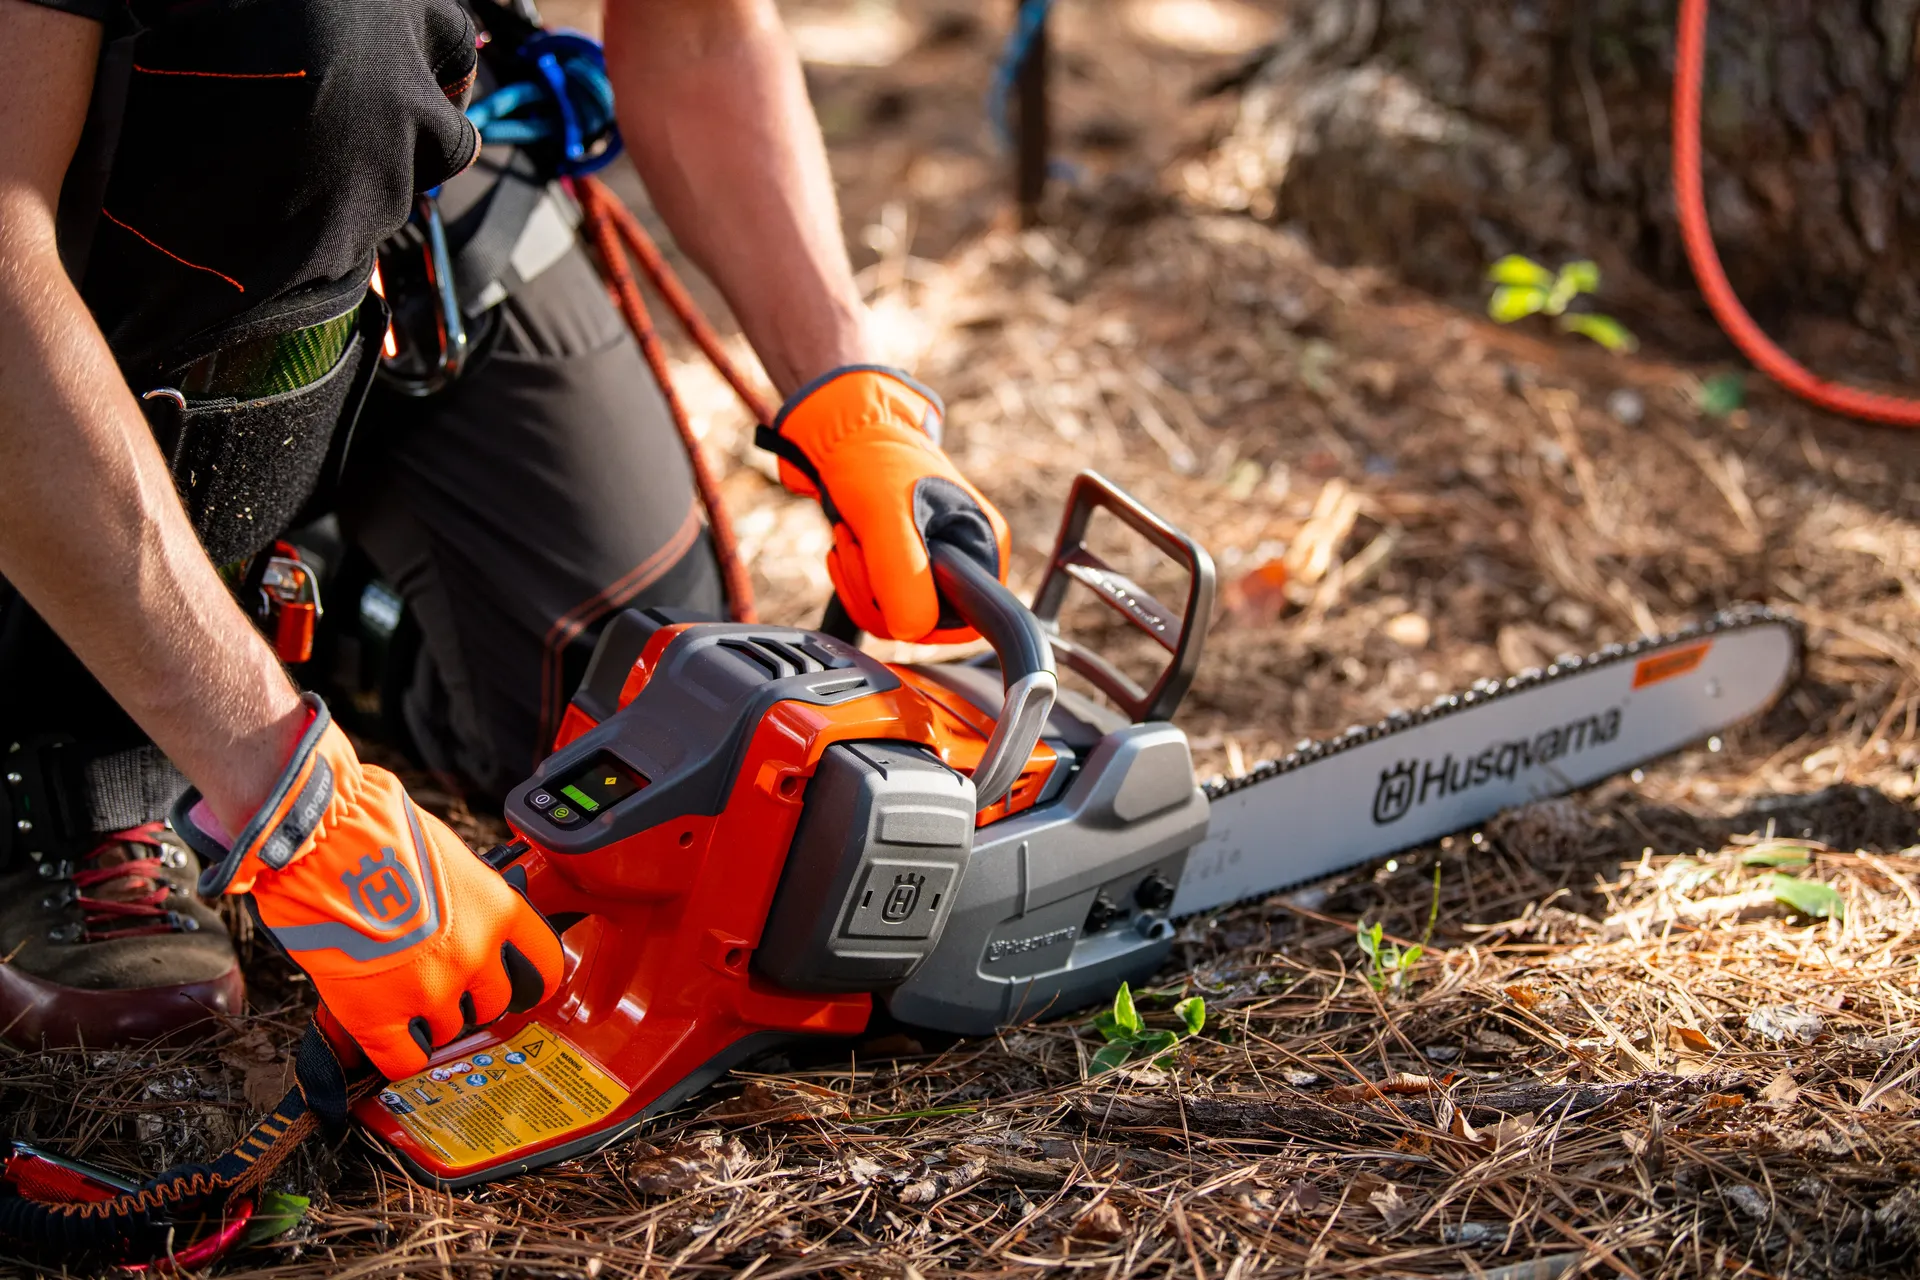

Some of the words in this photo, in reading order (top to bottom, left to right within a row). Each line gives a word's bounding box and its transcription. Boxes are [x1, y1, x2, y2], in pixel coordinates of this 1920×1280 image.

[1418, 707, 1622, 805] Husqvarna
[560, 1052, 583, 1070] WARNING
[471, 1093, 505, 1121] ADVERTENCIA
